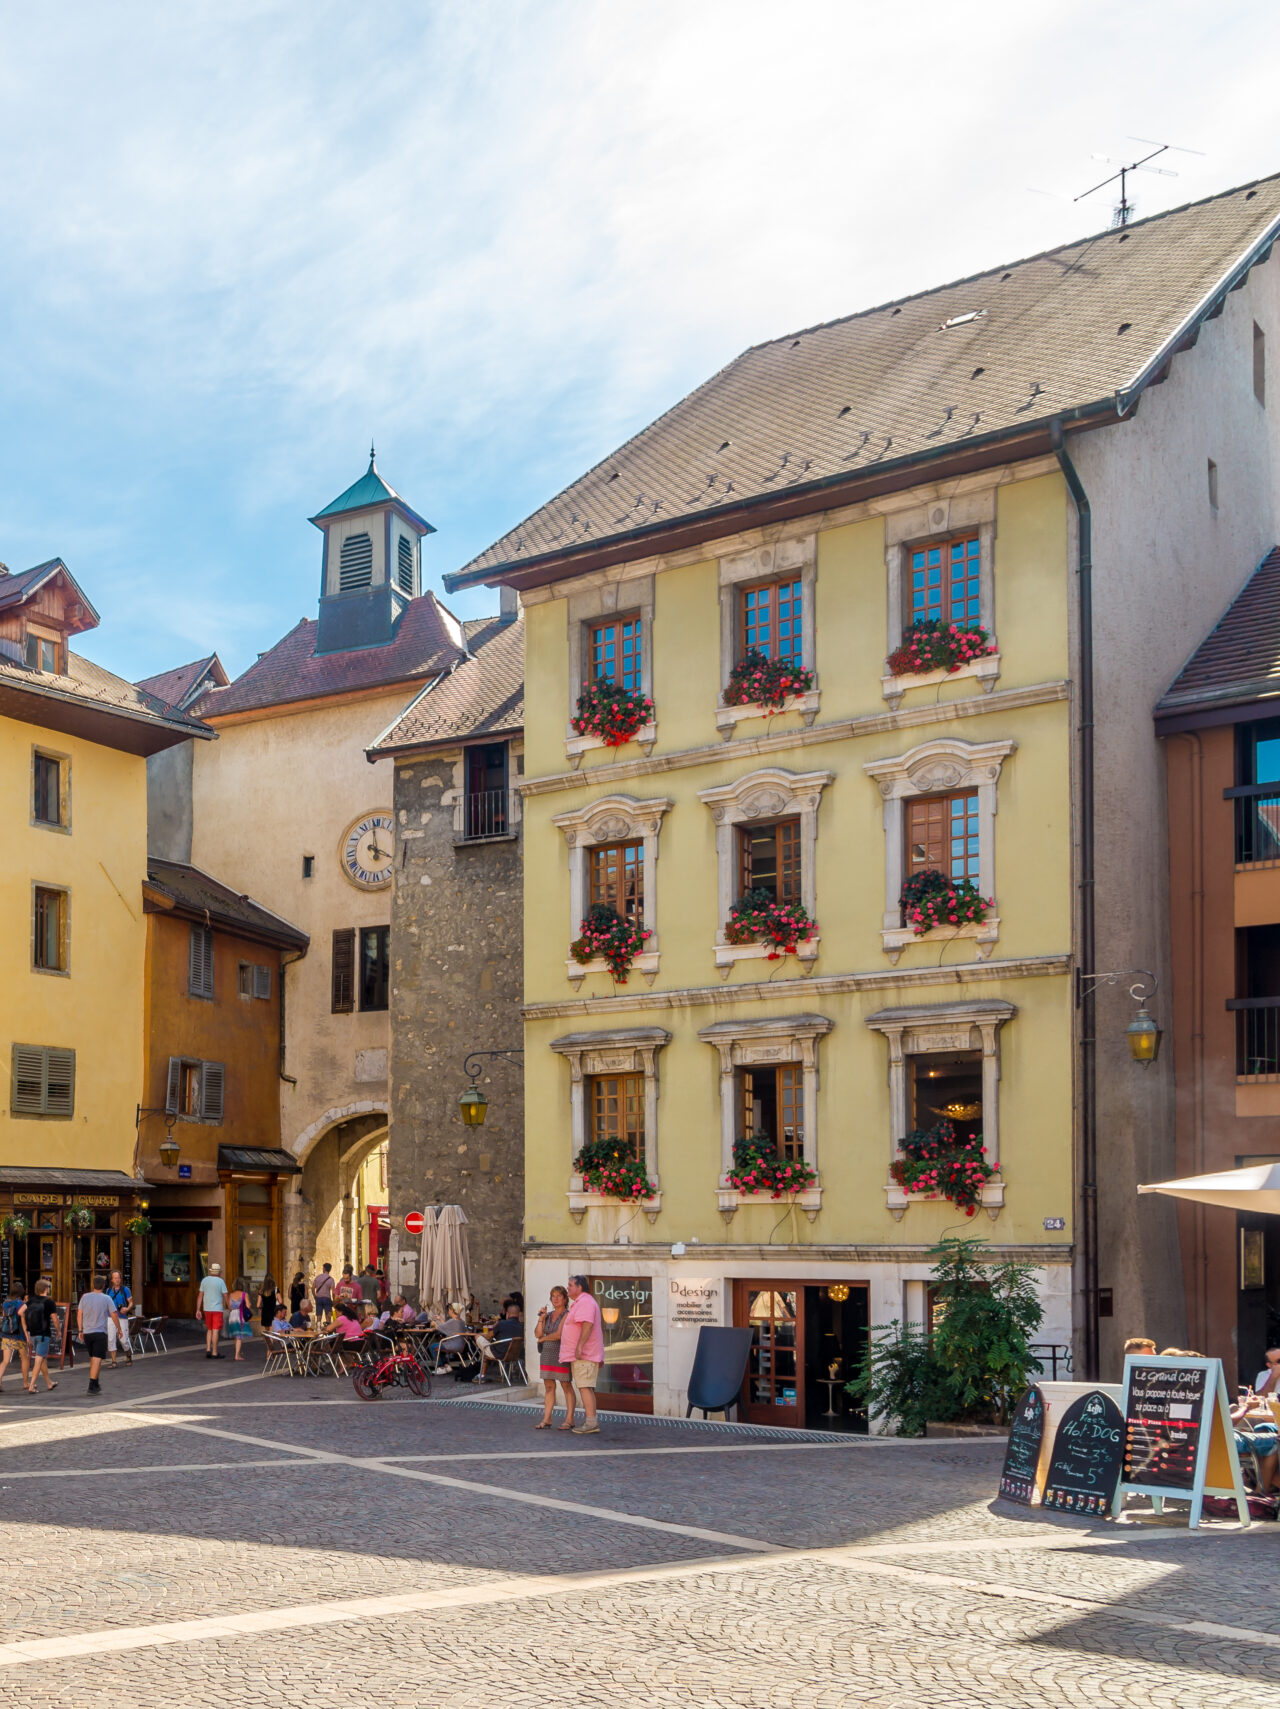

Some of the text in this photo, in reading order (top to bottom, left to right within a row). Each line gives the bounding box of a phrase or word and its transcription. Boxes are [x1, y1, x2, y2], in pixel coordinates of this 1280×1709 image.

[1046, 1219, 1061, 1229] 24
[1135, 1370, 1147, 1380] Le
[1132, 1386, 1144, 1397] Vous
[1145, 1389, 1166, 1398] propose
[1171, 1389, 1185, 1399] toute
[1186, 1388, 1201, 1400] heure
[1142, 1402, 1157, 1412] place
